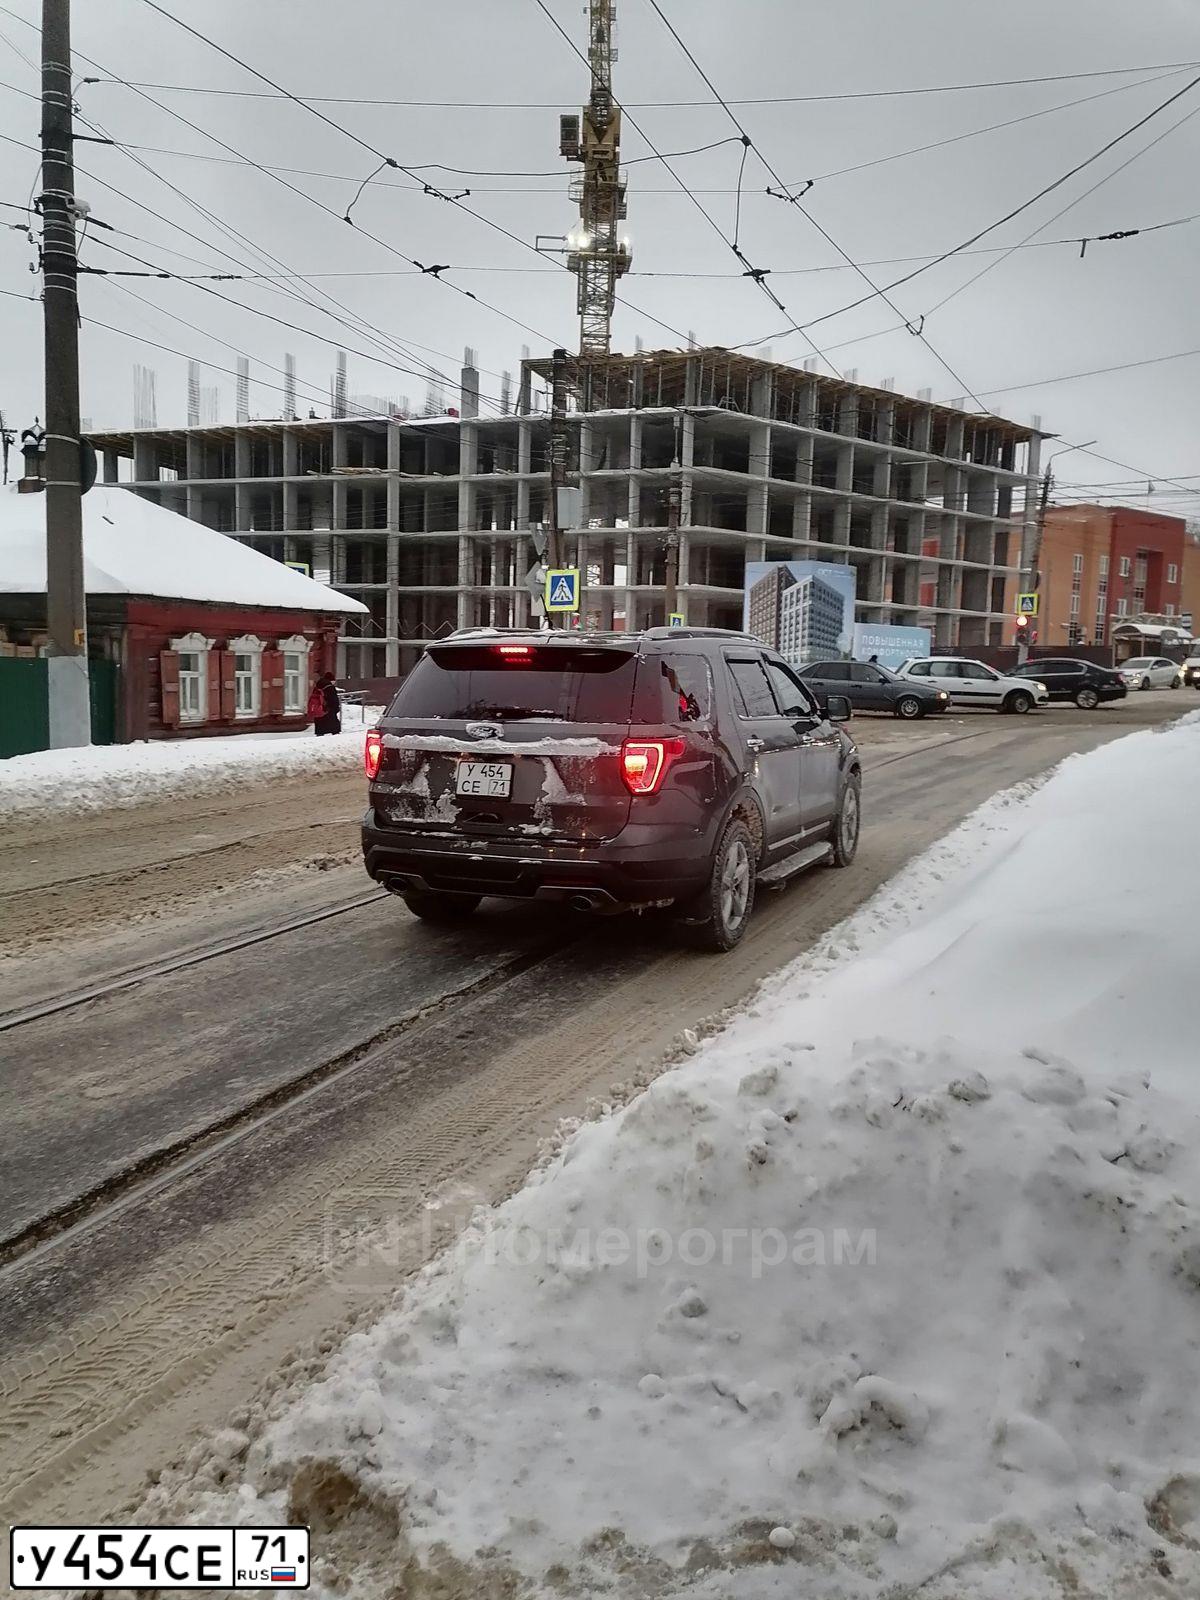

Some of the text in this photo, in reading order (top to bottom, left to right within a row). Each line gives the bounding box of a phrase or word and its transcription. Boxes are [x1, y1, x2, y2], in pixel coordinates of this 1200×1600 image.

[862, 635, 925, 648] ПОВЫШЕННАЯ
[467, 764, 503, 778] У 454
[461, 780, 506, 793] СЕ 71
